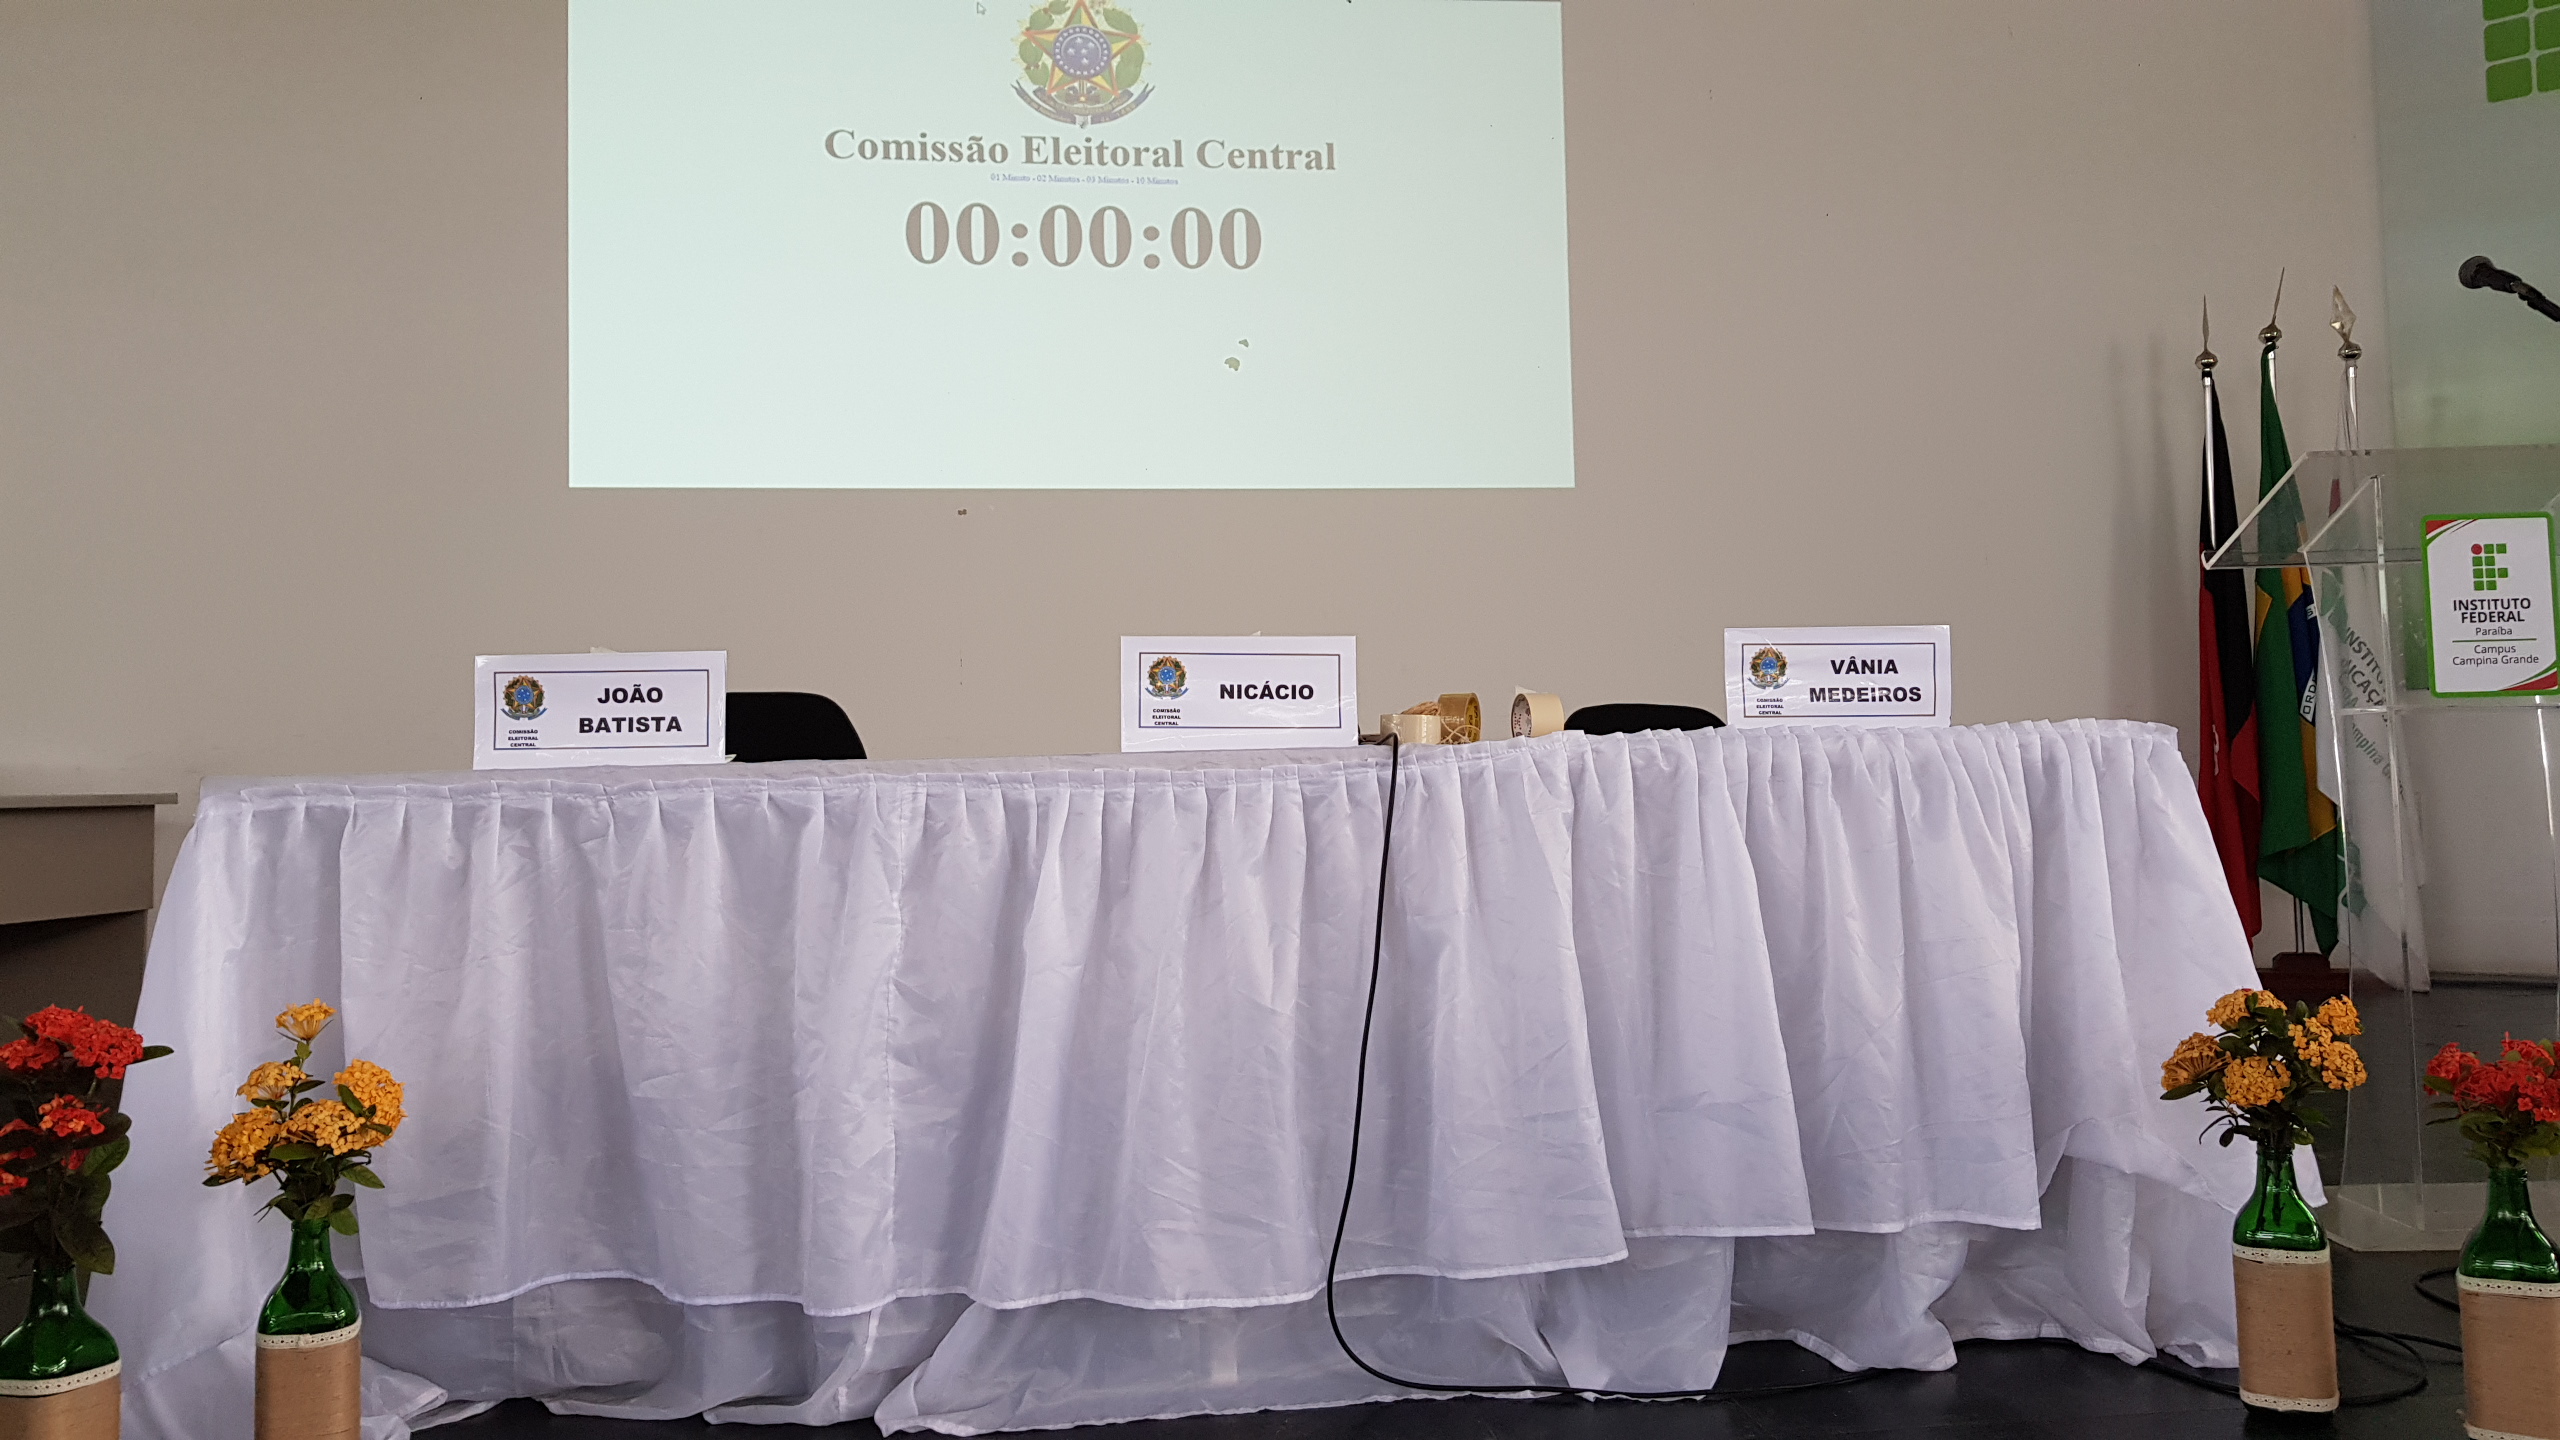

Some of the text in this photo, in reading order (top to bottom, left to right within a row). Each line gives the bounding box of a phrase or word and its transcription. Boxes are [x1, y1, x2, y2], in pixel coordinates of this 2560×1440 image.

[825, 129, 1336, 171] Comissão Eleitoral Central
[905, 201, 1262, 270] 00:00:00
[2453, 597, 2532, 612] INSTITUTO
[2461, 610, 2526, 623] FEDERAL
[2475, 626, 2513, 636] Paraíba
[2474, 644, 2517, 655] Campus
[1829, 655, 1899, 675] VÂNIA
[2452, 654, 2540, 668] Campina Grande
[596, 683, 664, 705] JOÃO
[1219, 680, 1315, 701] NICÁCIO
[1809, 686, 1922, 703] MEDEIROS
[578, 715, 683, 734] BATISTA
